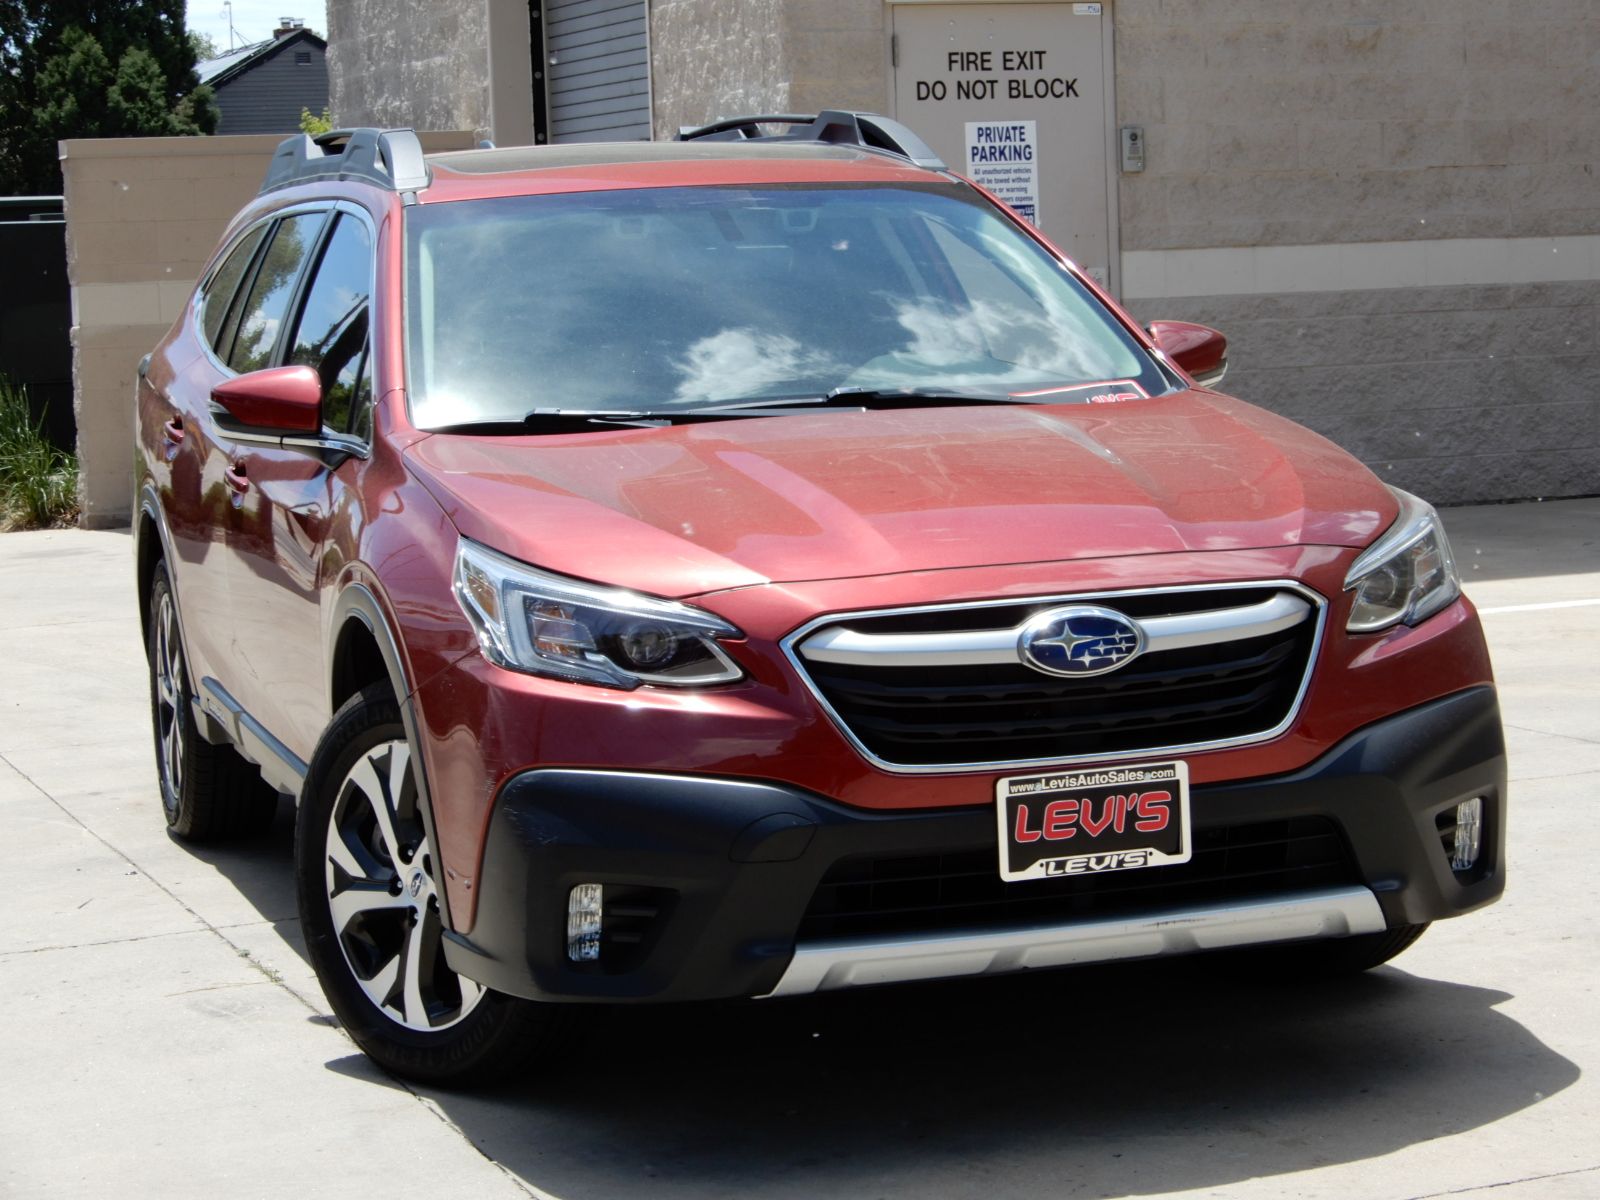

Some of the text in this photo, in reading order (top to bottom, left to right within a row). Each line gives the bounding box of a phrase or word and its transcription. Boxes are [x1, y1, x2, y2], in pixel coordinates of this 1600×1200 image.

[948, 50, 1047, 72] FIRE EXIT
[916, 78, 1079, 101] DO NOT BLOCK
[977, 125, 1026, 143] PRIVATE
[971, 144, 1032, 162] PARKING
[982, 167, 1012, 175] unauthorized
[1006, 186, 1027, 194] warning
[1010, 768, 1174, 793] wwwLevisAutoSalescom
[1015, 790, 1172, 843] LEVI'S
[1047, 851, 1146, 875] LEVI'S
